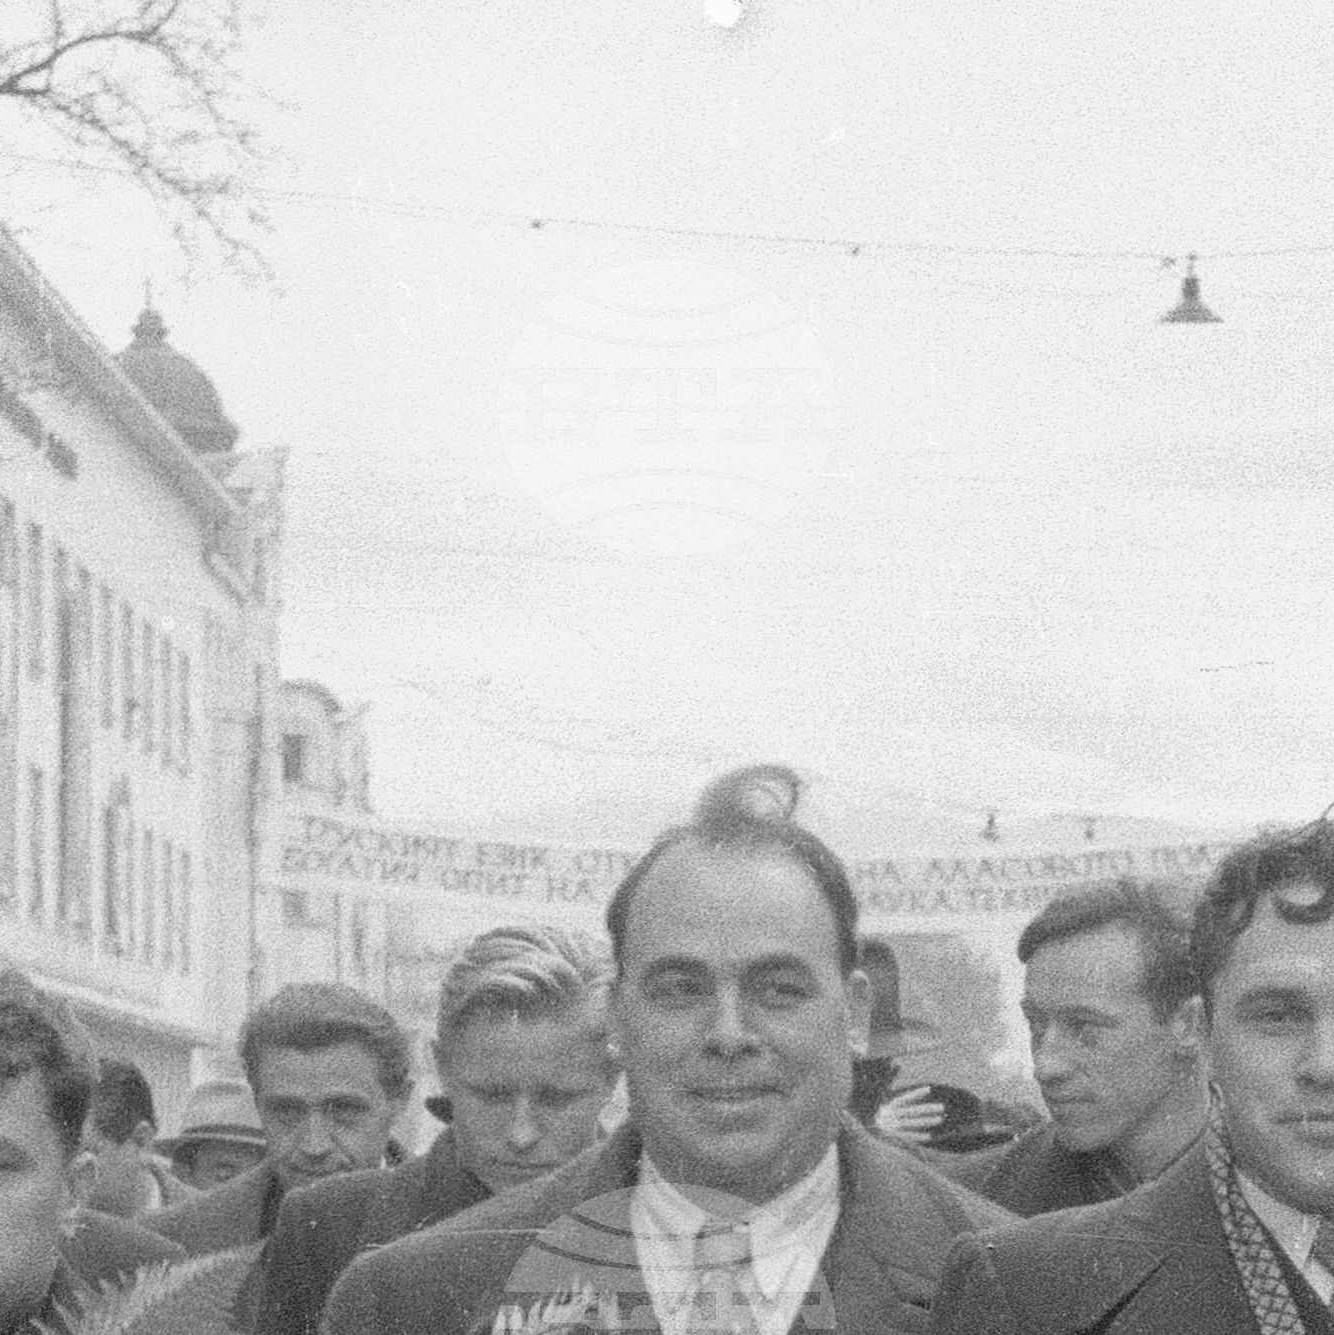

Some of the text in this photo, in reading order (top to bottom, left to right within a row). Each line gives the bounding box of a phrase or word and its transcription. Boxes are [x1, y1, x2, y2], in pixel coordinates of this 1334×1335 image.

[476, 842, 549, 870] ЕЗИК
[440, 866, 530, 898] ОПИТ
[546, 874, 597, 903] НА
